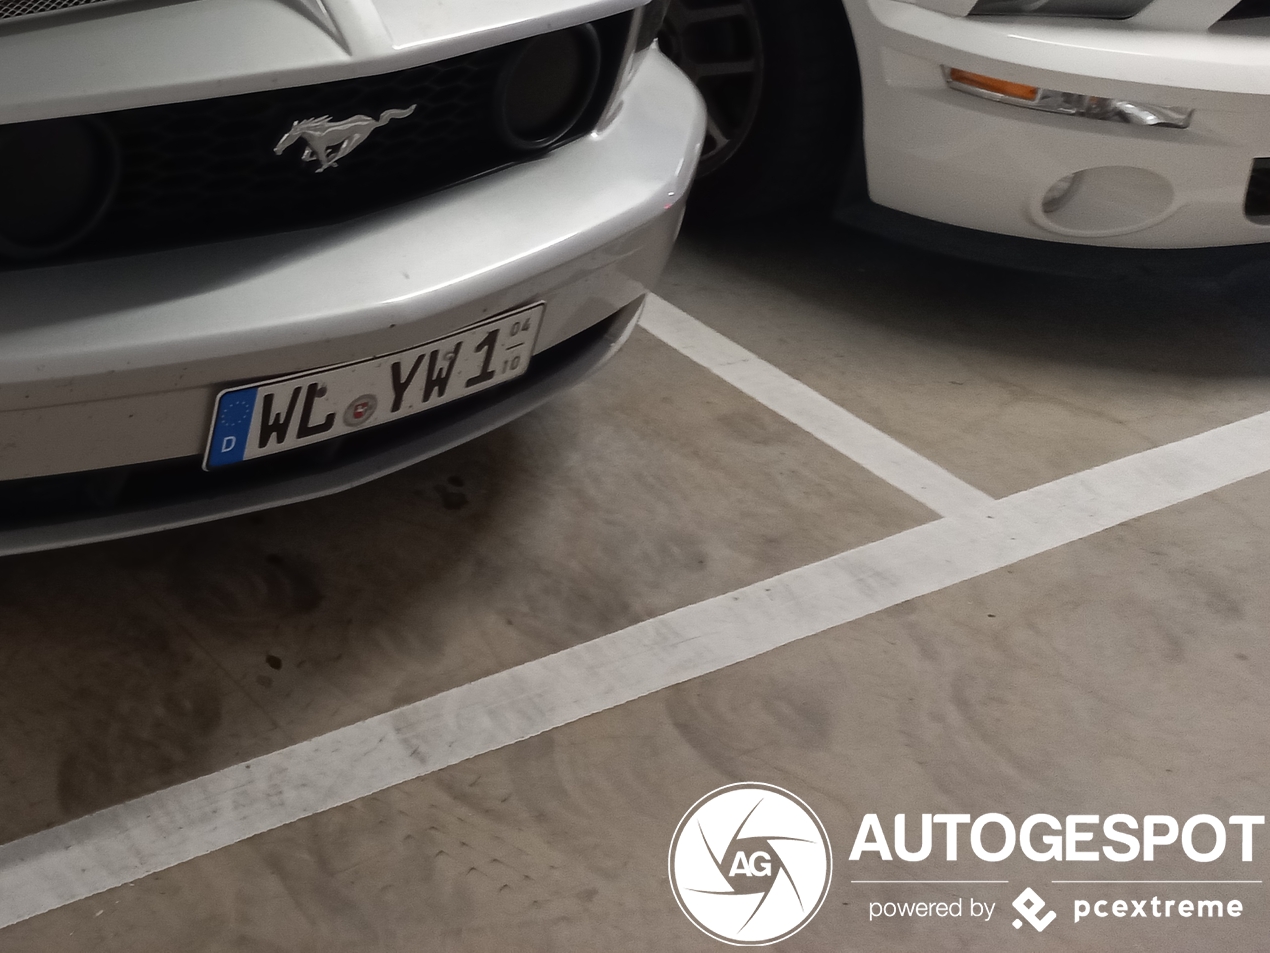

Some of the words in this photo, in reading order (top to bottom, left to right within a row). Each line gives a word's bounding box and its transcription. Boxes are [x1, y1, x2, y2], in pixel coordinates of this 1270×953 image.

[510, 317, 531, 337] 04
[501, 355, 521, 375] 10
[221, 436, 236, 453] D
